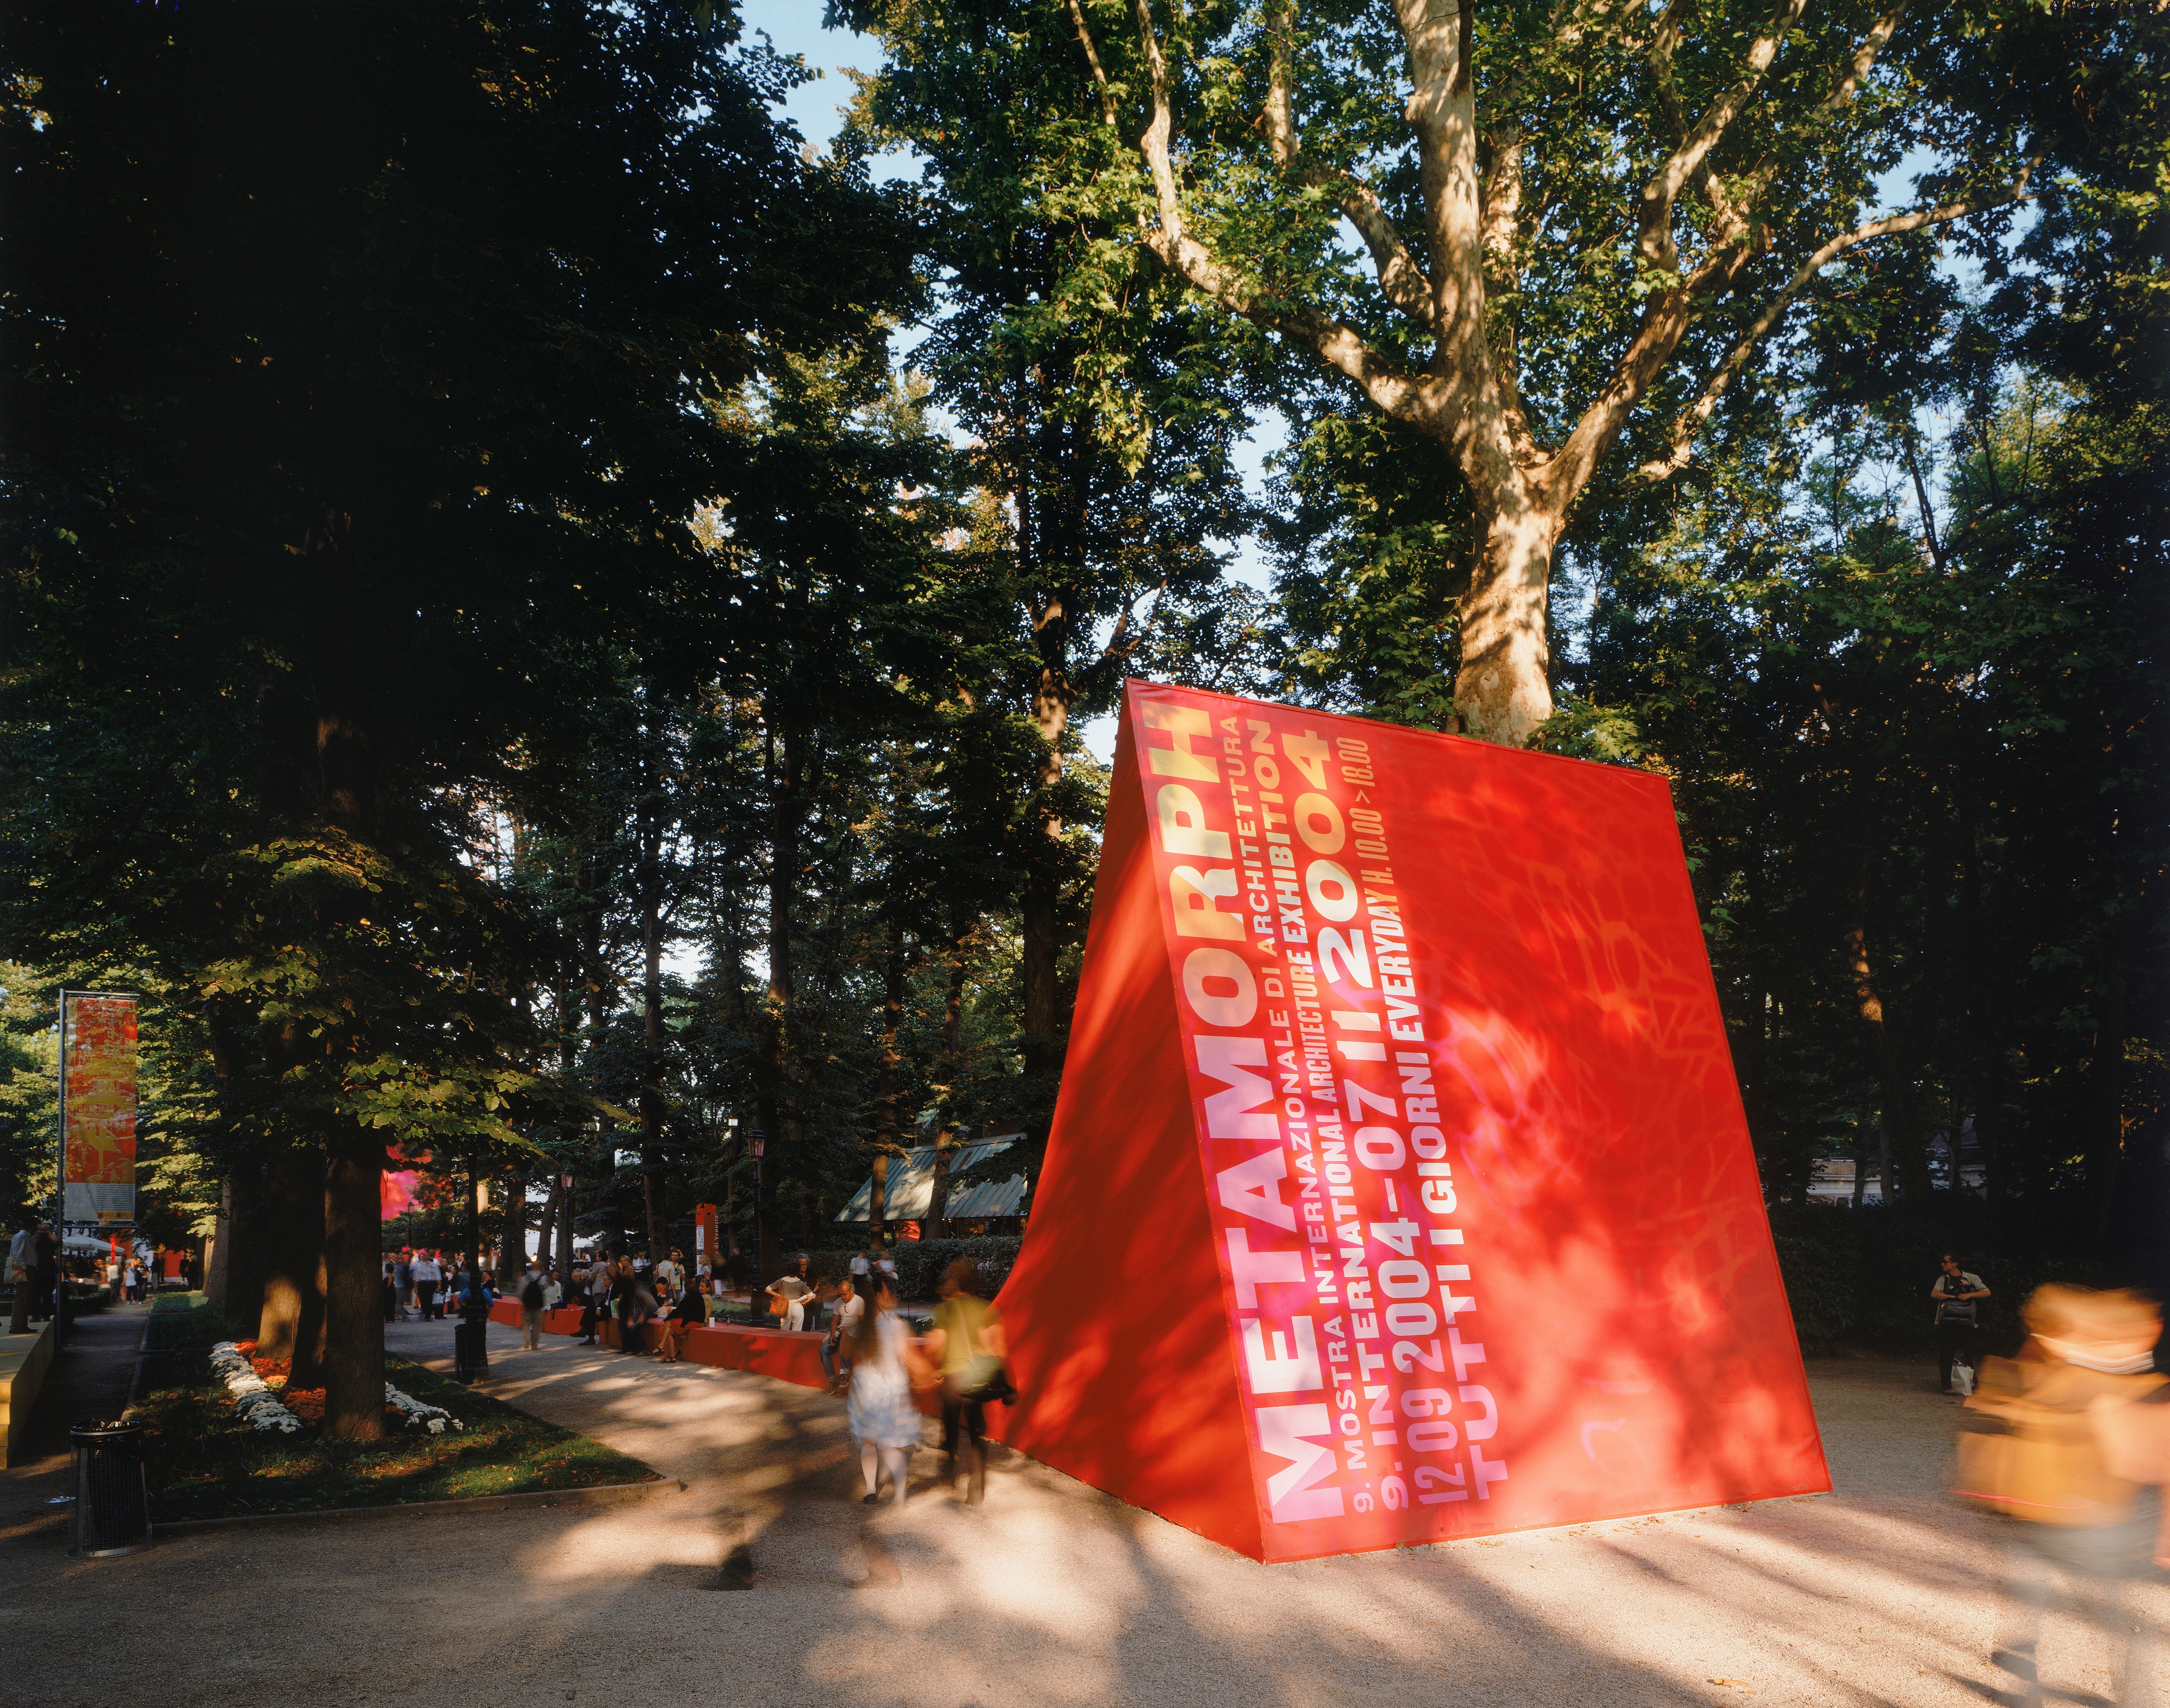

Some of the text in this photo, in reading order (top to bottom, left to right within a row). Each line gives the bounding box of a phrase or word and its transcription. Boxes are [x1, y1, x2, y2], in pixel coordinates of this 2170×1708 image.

[1337, 737, 1375, 787] 18.00
[1281, 730, 1373, 988] 2004
[1349, 808, 1389, 861] 10.00
[1362, 868, 1394, 885] H.
[1364, 891, 1425, 1042] EVERYDAY
[1331, 1010, 1387, 1062] 11
[1141, 700, 1345, 1523] METAMORPH
[1220, 717, 1374, 1513] 9. MOSTRA INTERNAZIONALE DI ARCHITETTURA
[1246, 718, 1409, 1510] 9. INTERNATIONAL ARCHITECTURE EXHIBITION
[1396, 1052, 1457, 1214] GIORNI
[1430, 1229, 1465, 1245] I
[1401, 1388, 1458, 1452] 09
[1436, 1264, 1508, 1500] TUTTI
[1414, 1463, 1469, 1505] 12
